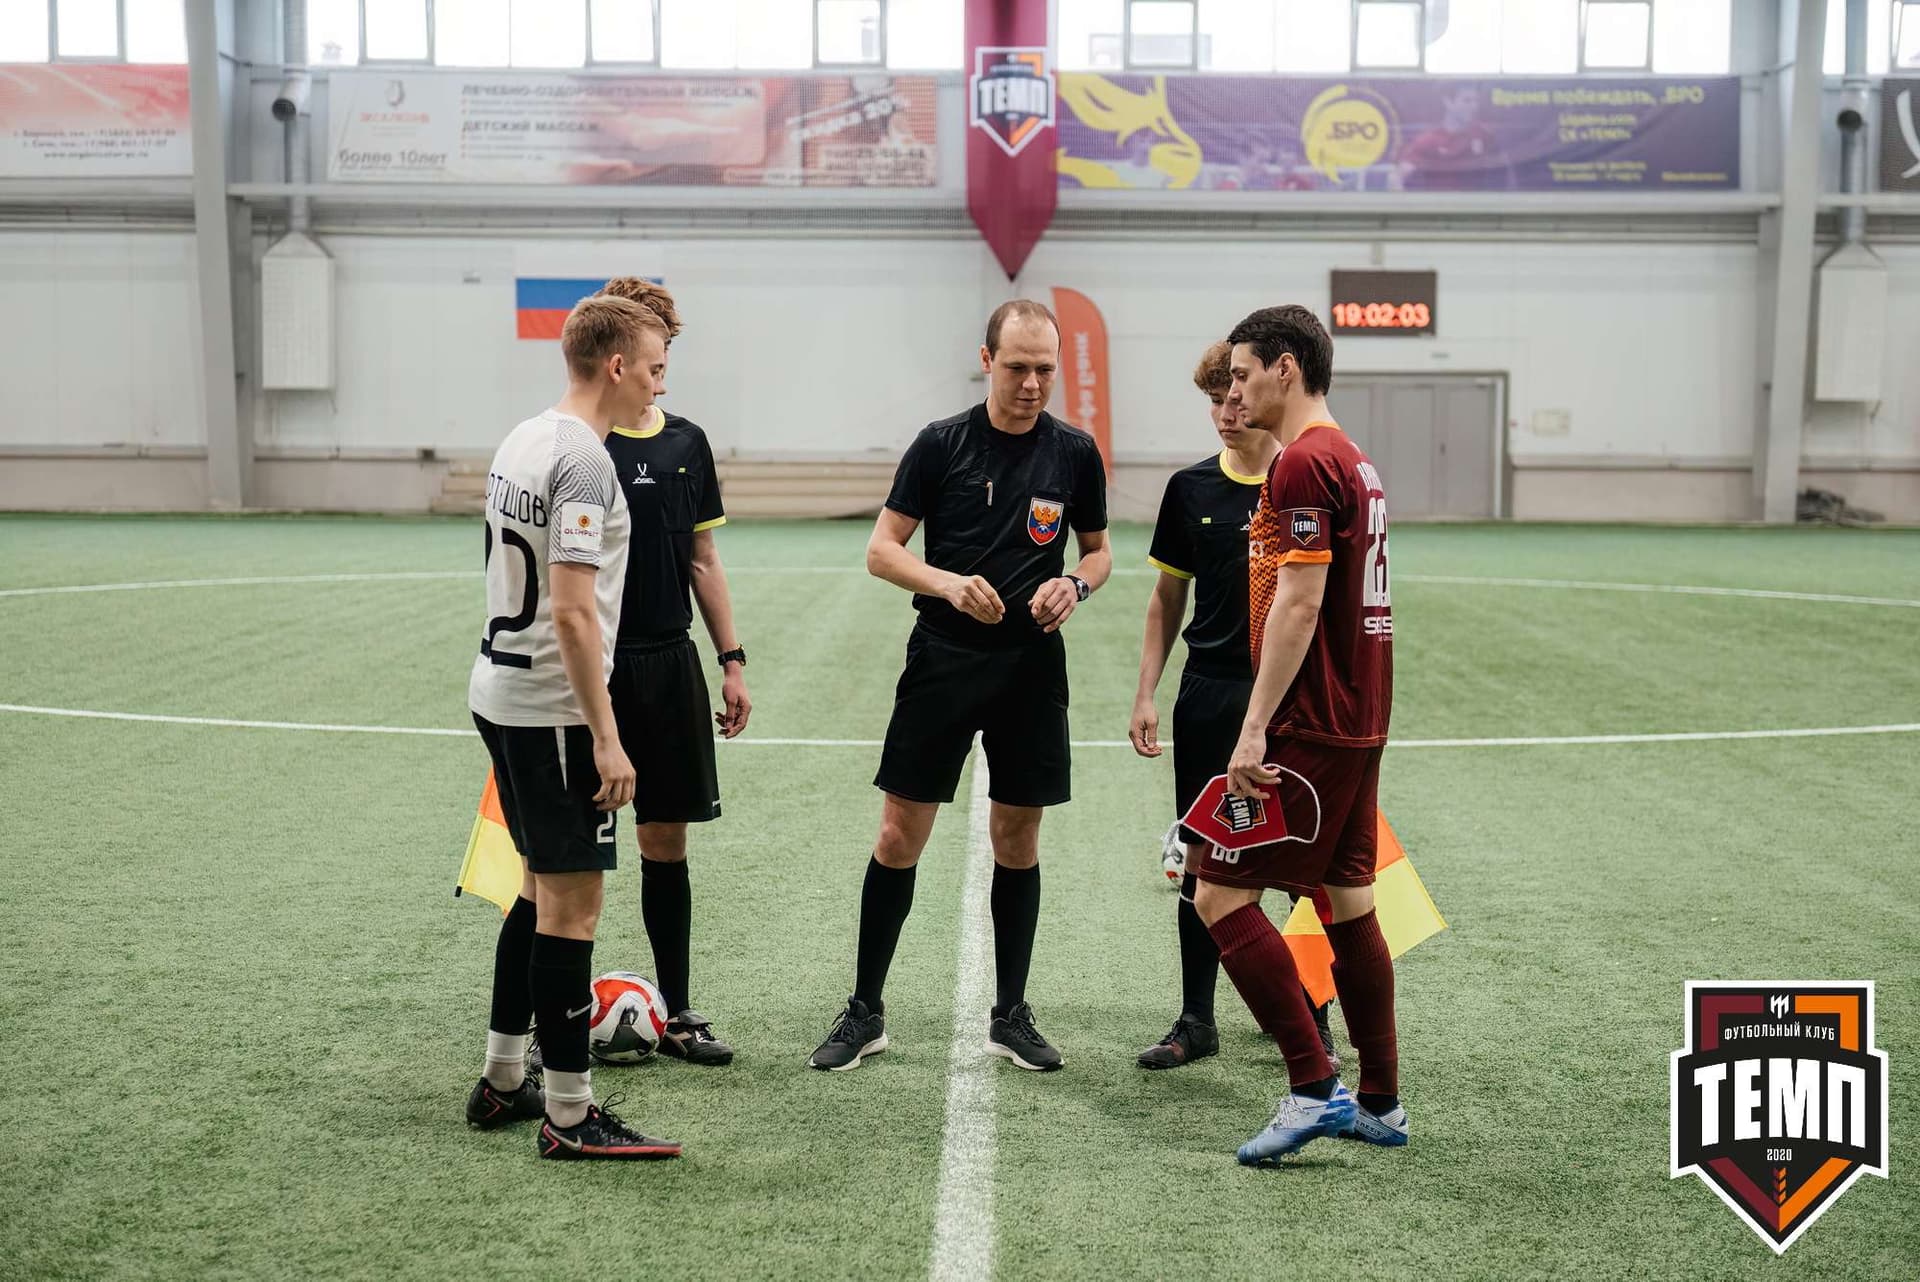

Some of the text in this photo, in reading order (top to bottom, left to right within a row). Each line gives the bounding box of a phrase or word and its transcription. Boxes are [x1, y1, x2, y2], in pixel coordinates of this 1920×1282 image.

[979, 78, 1047, 115] ТЕМП
[1332, 302, 1430, 328] 19:02:03
[1293, 519, 1318, 534] ТЕМП
